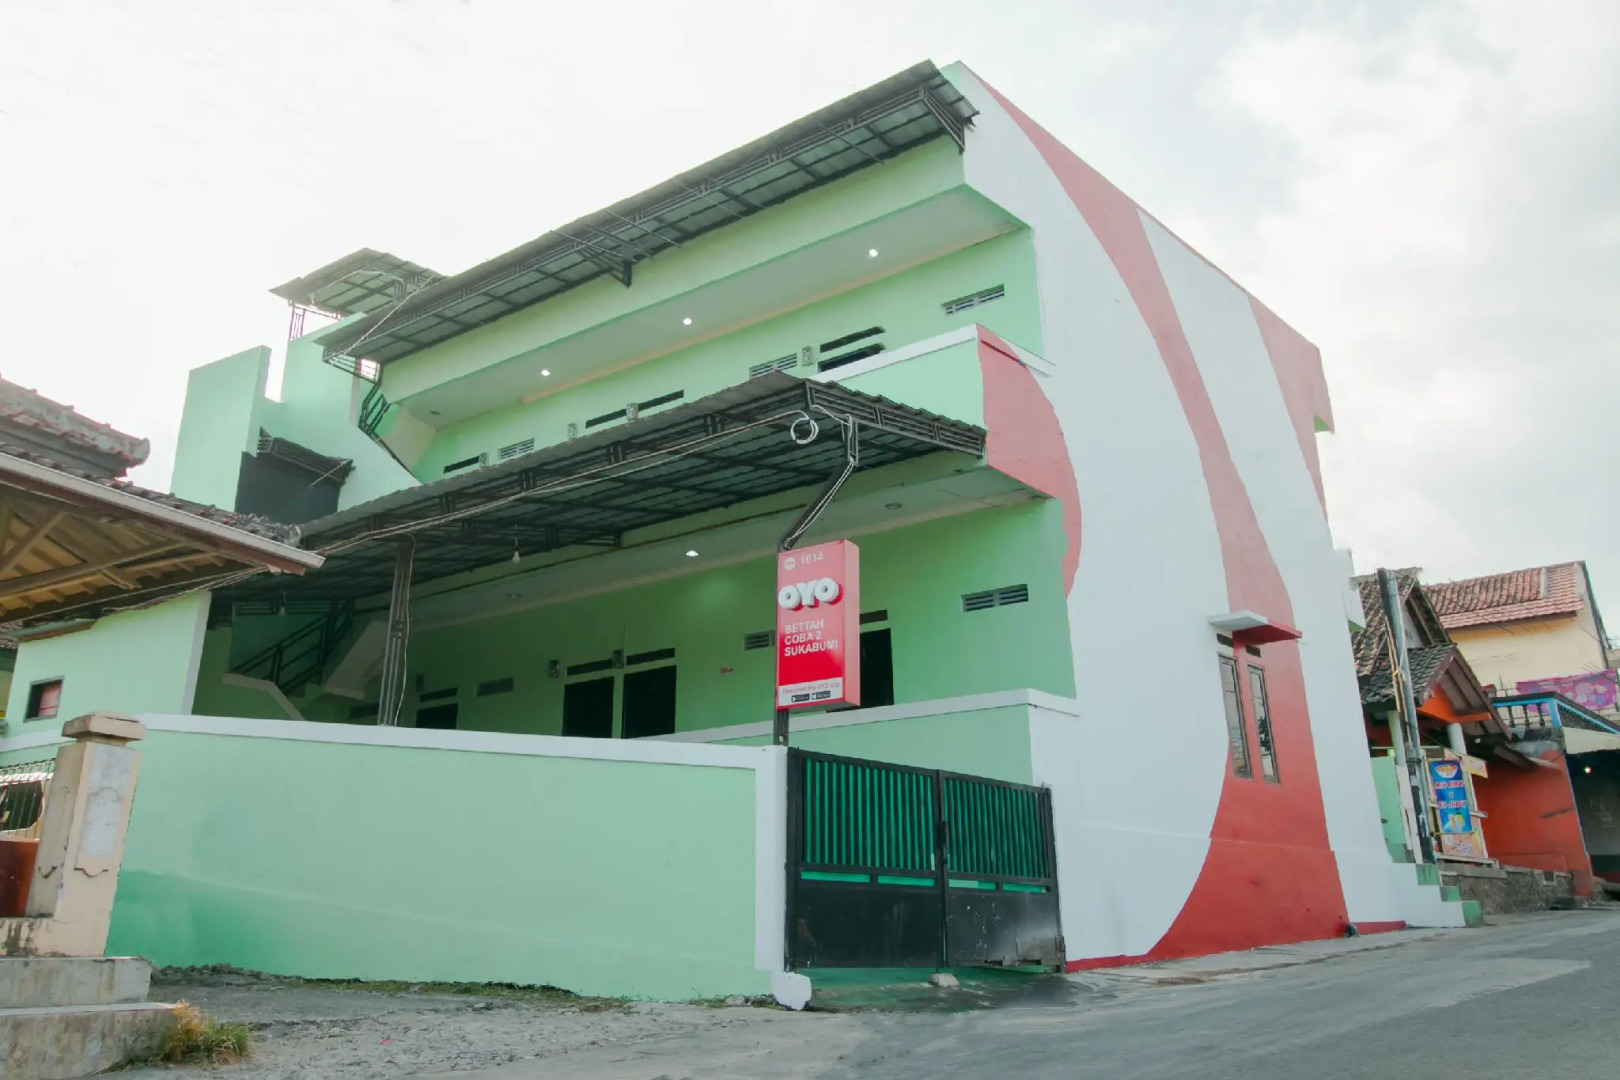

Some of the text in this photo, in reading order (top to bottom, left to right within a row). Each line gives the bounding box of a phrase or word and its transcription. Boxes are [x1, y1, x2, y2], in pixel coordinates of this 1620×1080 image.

[778, 577, 839, 610] OYO
[784, 619, 824, 634] BETTAH
[784, 630, 822, 646] COBA 2
[784, 639, 838, 657] SUKABUMI
